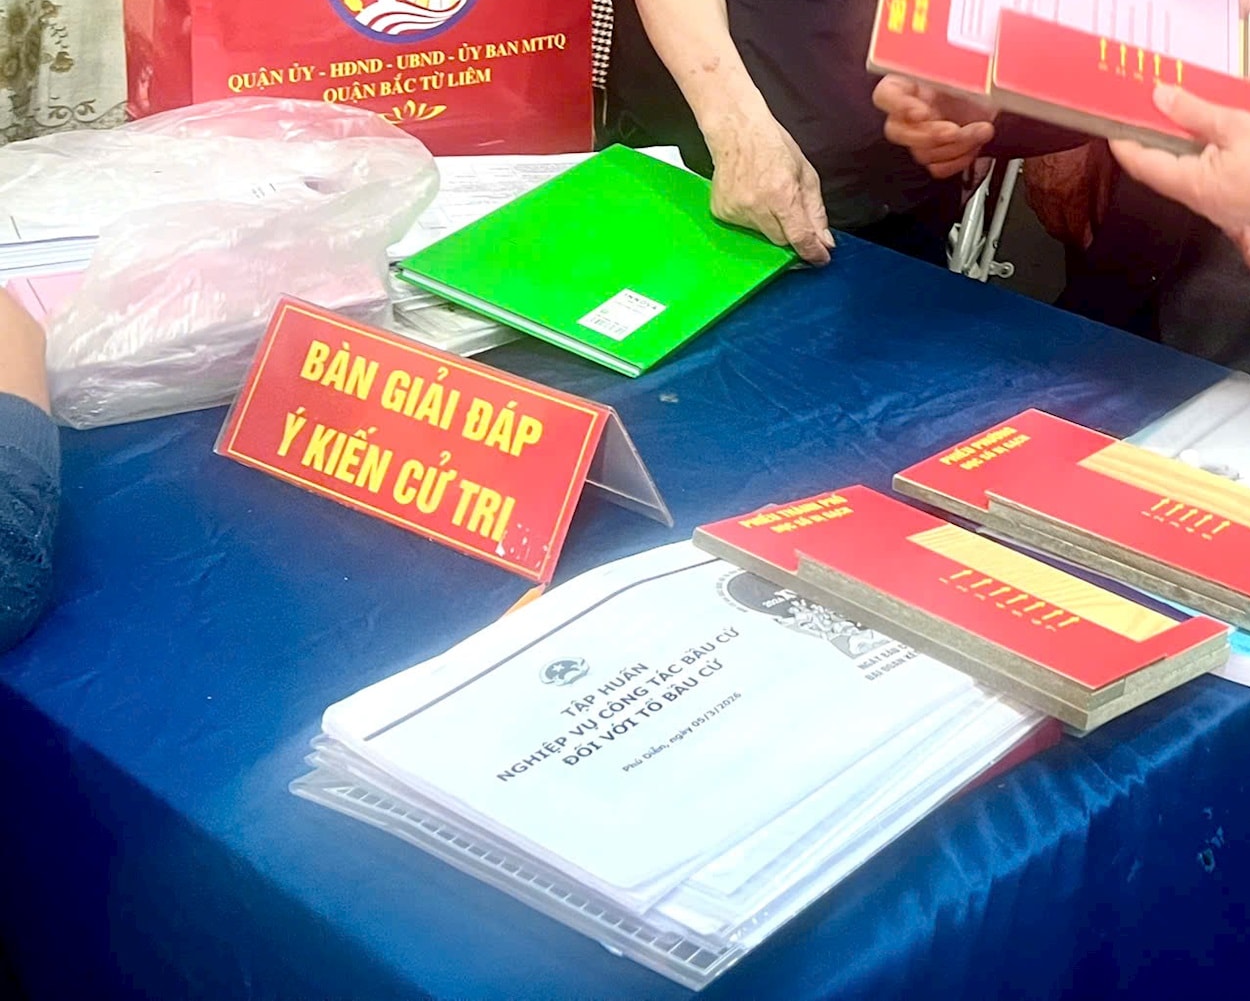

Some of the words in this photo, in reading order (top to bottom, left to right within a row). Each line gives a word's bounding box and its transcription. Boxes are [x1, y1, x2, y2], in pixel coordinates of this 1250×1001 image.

[227, 66, 284, 92] QUẬN
[288, 60, 317, 84] ỦY
[396, 50, 446, 72] UBND
[458, 43, 483, 65] ỦY
[485, 38, 520, 60] BAN
[521, 32, 567, 53] MTTQ
[322, 83, 376, 105] QUẬN
[380, 72, 417, 96] BẮC
[419, 67, 446, 91] TỪ
[447, 66, 493, 88] LIÊM
[299, 340, 381, 402] BÀN
[381, 366, 461, 433] GIẢI
[462, 398, 544, 458] ĐÁP
[276, 407, 307, 457] Ý
[301, 421, 394, 494] KIẾN
[393, 450, 458, 515] CỬ
[496, 735, 569, 783] NGHIỆP
[568, 717, 600, 739] VỤ
[598, 685, 650, 721] CÔNG
[646, 663, 683, 692] TÁC
[680, 641, 717, 666] BẦU
[714, 625, 741, 645] CỬ
[560, 694, 597, 720] TẬP
[598, 661, 650, 697] HUẤN
[562, 740, 603, 767] ĐỐI
[599, 716, 640, 743] VỚI
[635, 697, 664, 722] TỔ
[661, 675, 700, 703] BẦU
[698, 657, 724, 679] CỬ
[621, 757, 644, 773] Phú
[669, 726, 694, 745] ngày
[691, 691, 742, 728] 05/3/2026
